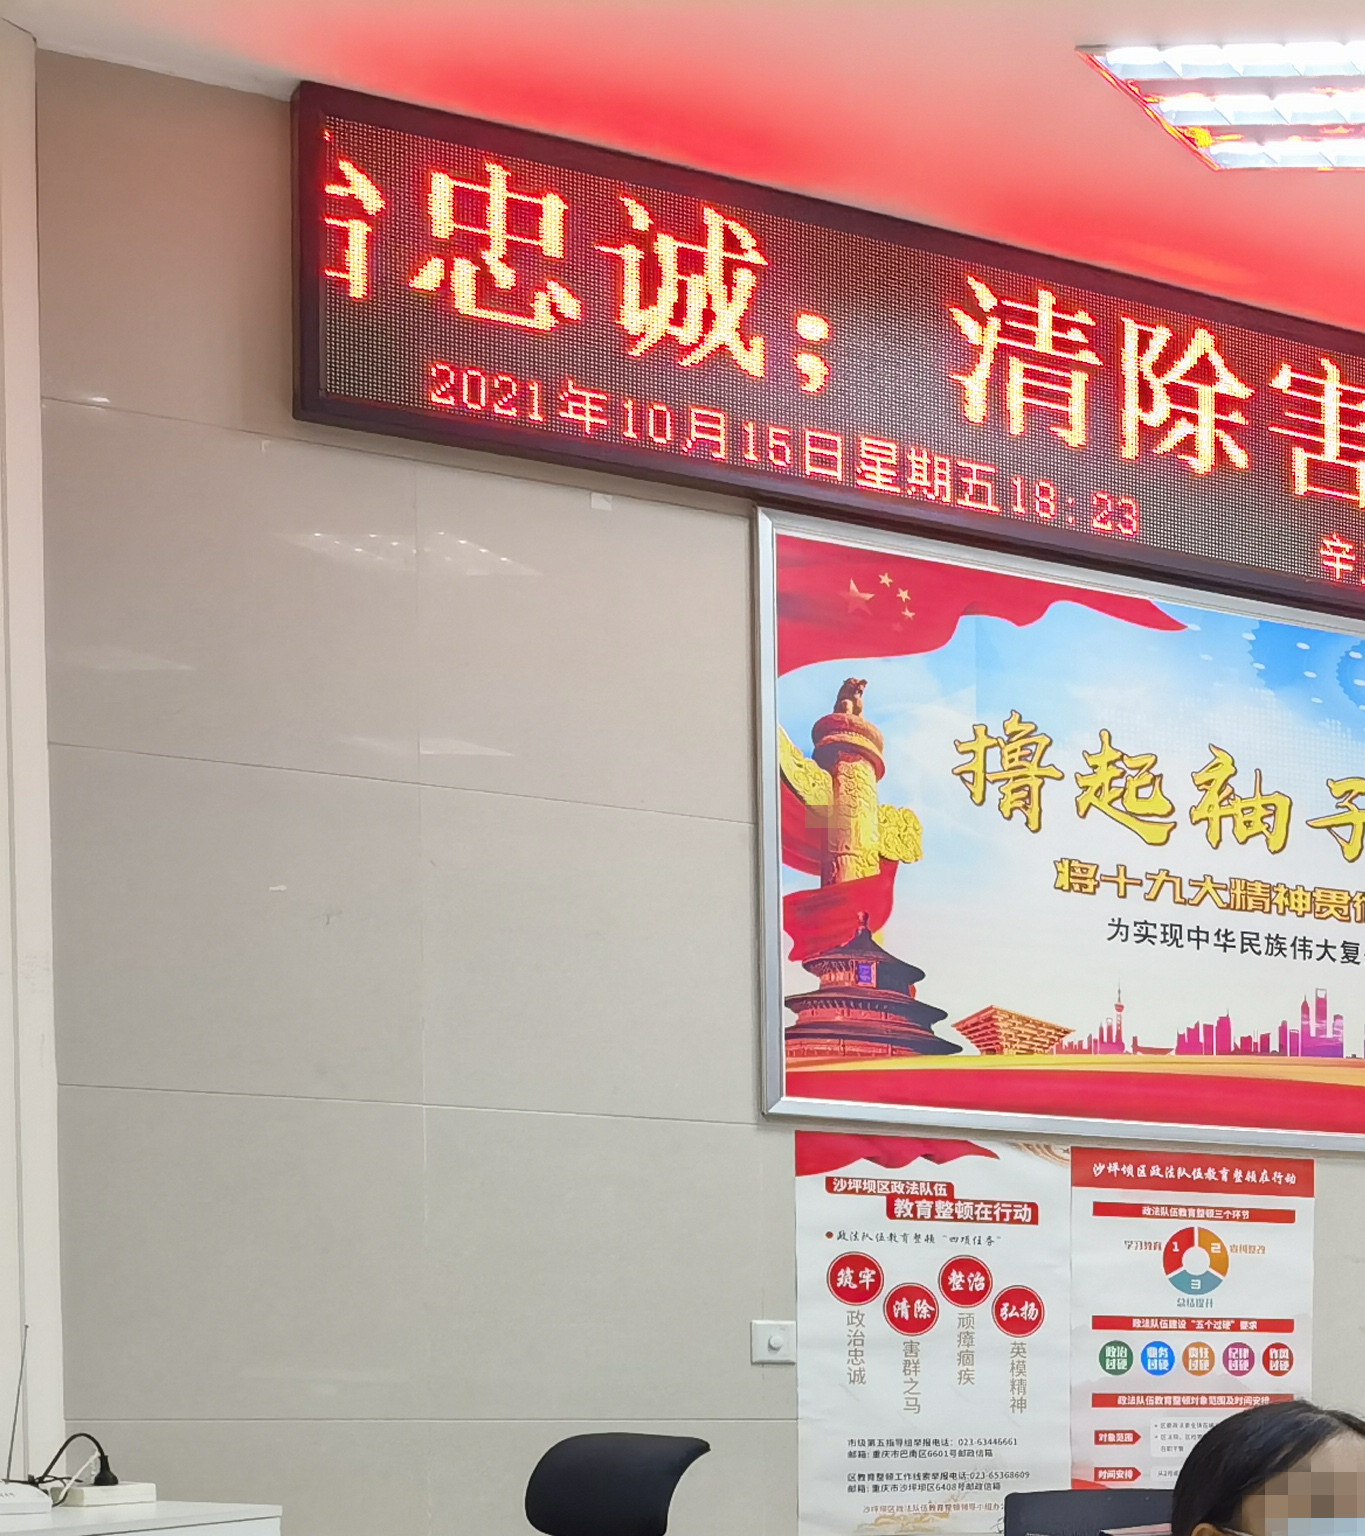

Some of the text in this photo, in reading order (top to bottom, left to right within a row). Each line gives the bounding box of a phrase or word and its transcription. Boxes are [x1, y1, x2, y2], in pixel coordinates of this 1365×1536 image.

[1092, 1161, 1297, 1187] 沙坪坝区政法队伍教育整顿在行动
[832, 1177, 948, 1197] 沙坪坝区政法队伍
[893, 1198, 1032, 1223] 教育整顿在行动
[1141, 1205, 1251, 1221] 政法队伍教育整顿三个环节
[1171, 1241, 1181, 1253] 1
[1210, 1242, 1222, 1254] 2
[836, 1266, 877, 1290] 筑牢
[947, 1271, 986, 1292] 整治
[1190, 1278, 1202, 1290] 3
[892, 1297, 936, 1321] 清除
[999, 1301, 1039, 1321] 弘扬
[846, 1309, 867, 1386] 政治忠诚
[902, 1339, 921, 1415] 害群之马
[1008, 1341, 1028, 1415] 英模精神
